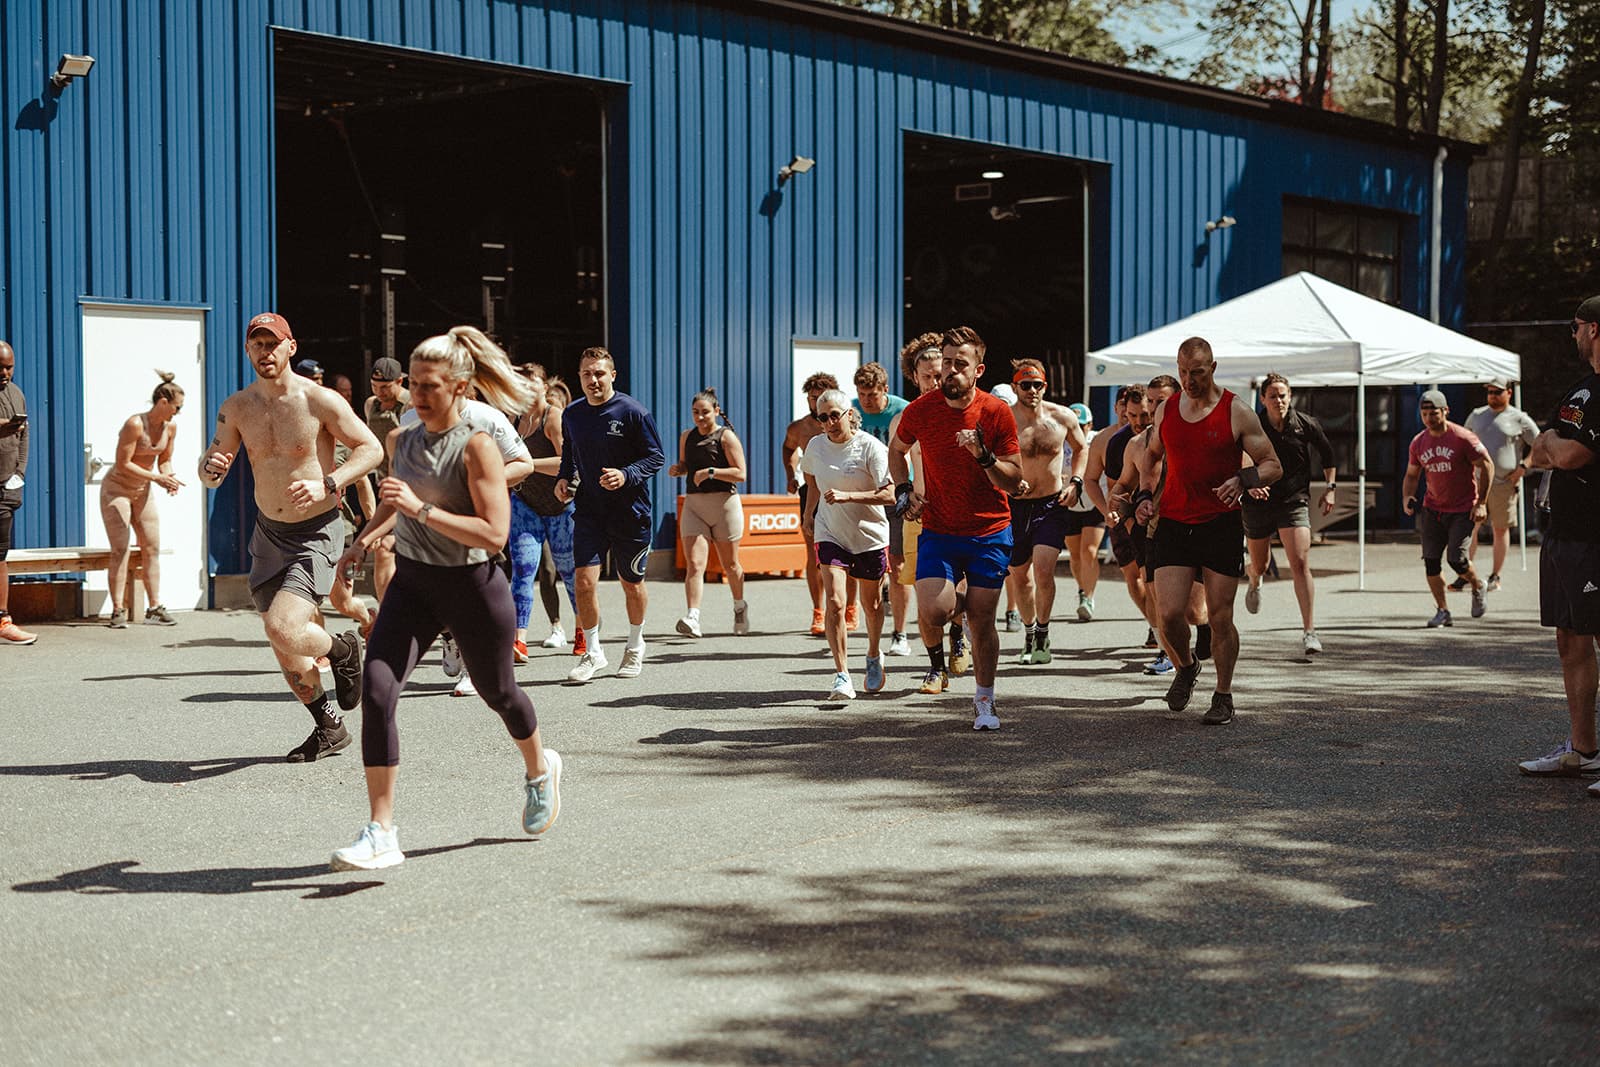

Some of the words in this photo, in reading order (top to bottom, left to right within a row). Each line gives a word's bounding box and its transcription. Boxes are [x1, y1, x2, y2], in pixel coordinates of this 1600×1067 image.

[1420, 447, 1435, 464] SIX
[1436, 445, 1455, 460] ONE
[749, 513, 800, 531] RIDGID
